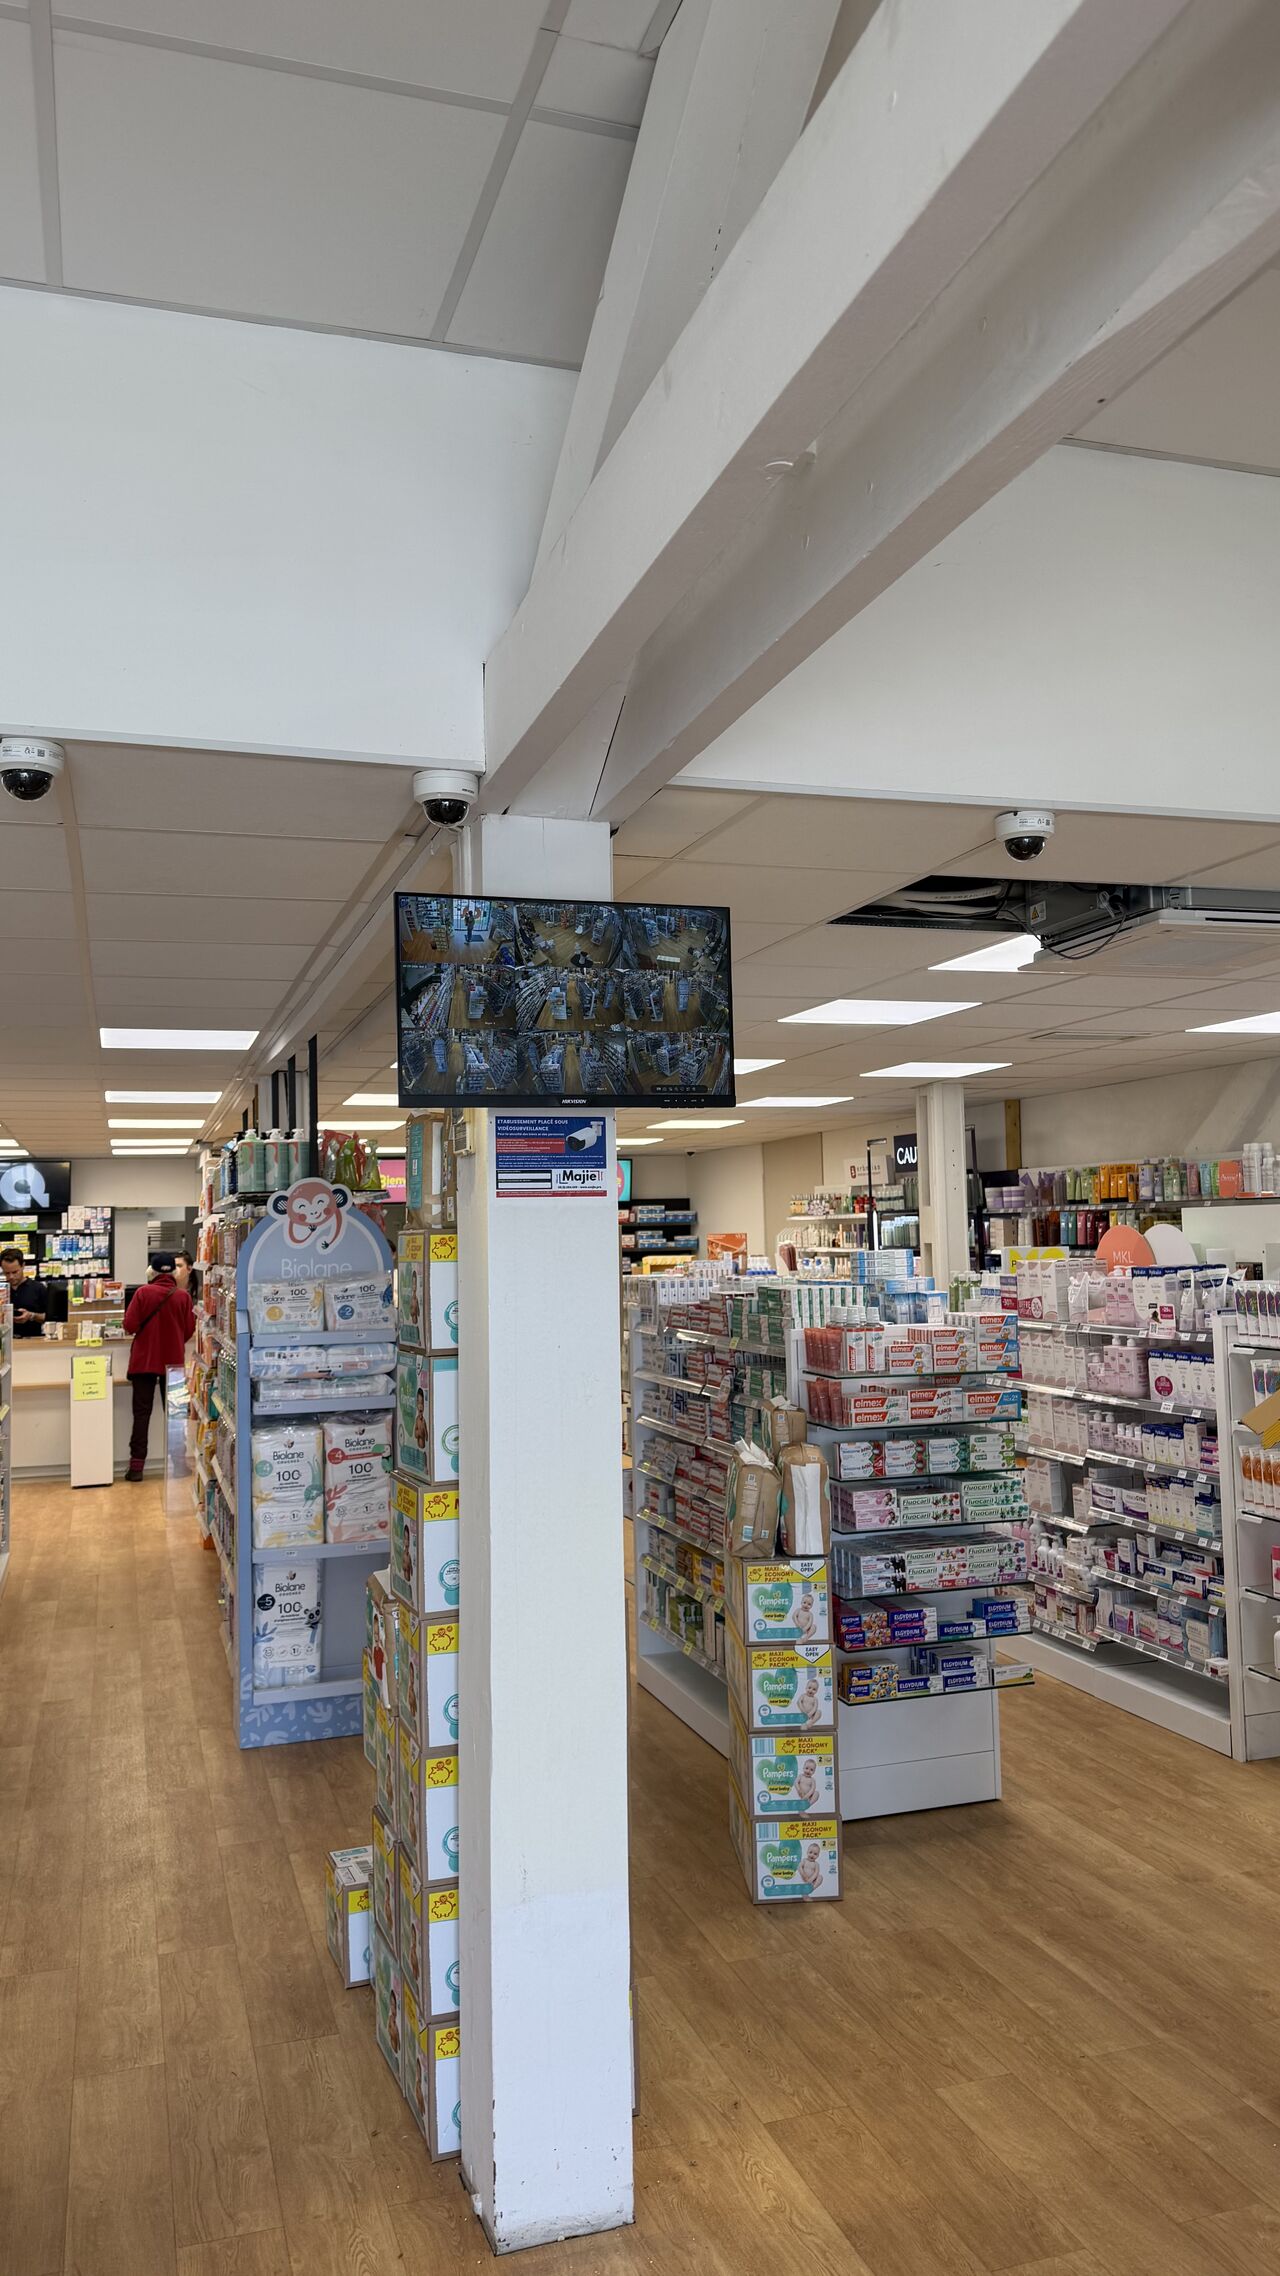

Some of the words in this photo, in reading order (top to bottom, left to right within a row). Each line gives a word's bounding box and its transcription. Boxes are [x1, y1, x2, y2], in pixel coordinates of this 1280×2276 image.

[563, 1170, 597, 1184] Majie
[1113, 1250, 1134, 1264] MKL
[281, 1258, 352, 1280] Biolane
[980, 1316, 1002, 1324] elmex
[980, 1343, 1003, 1351] elmex
[911, 1391, 934, 1399] elmex
[970, 1395, 996, 1403] elmex
[855, 1400, 882, 1408] elmex
[856, 1414, 883, 1422] elmex
[345, 1438, 376, 1448] Biolane
[272, 1451, 304, 1461] Biolane
[275, 1582, 306, 1593] Biolane
[265, 1596, 273, 1606] 5
[758, 1595, 789, 1607] Pampers
[763, 1680, 794, 1692] Pampers
[899, 1681, 924, 1689] ELGYDIUM
[762, 1768, 794, 1779] Pampers
[766, 1853, 798, 1864] Pampers
